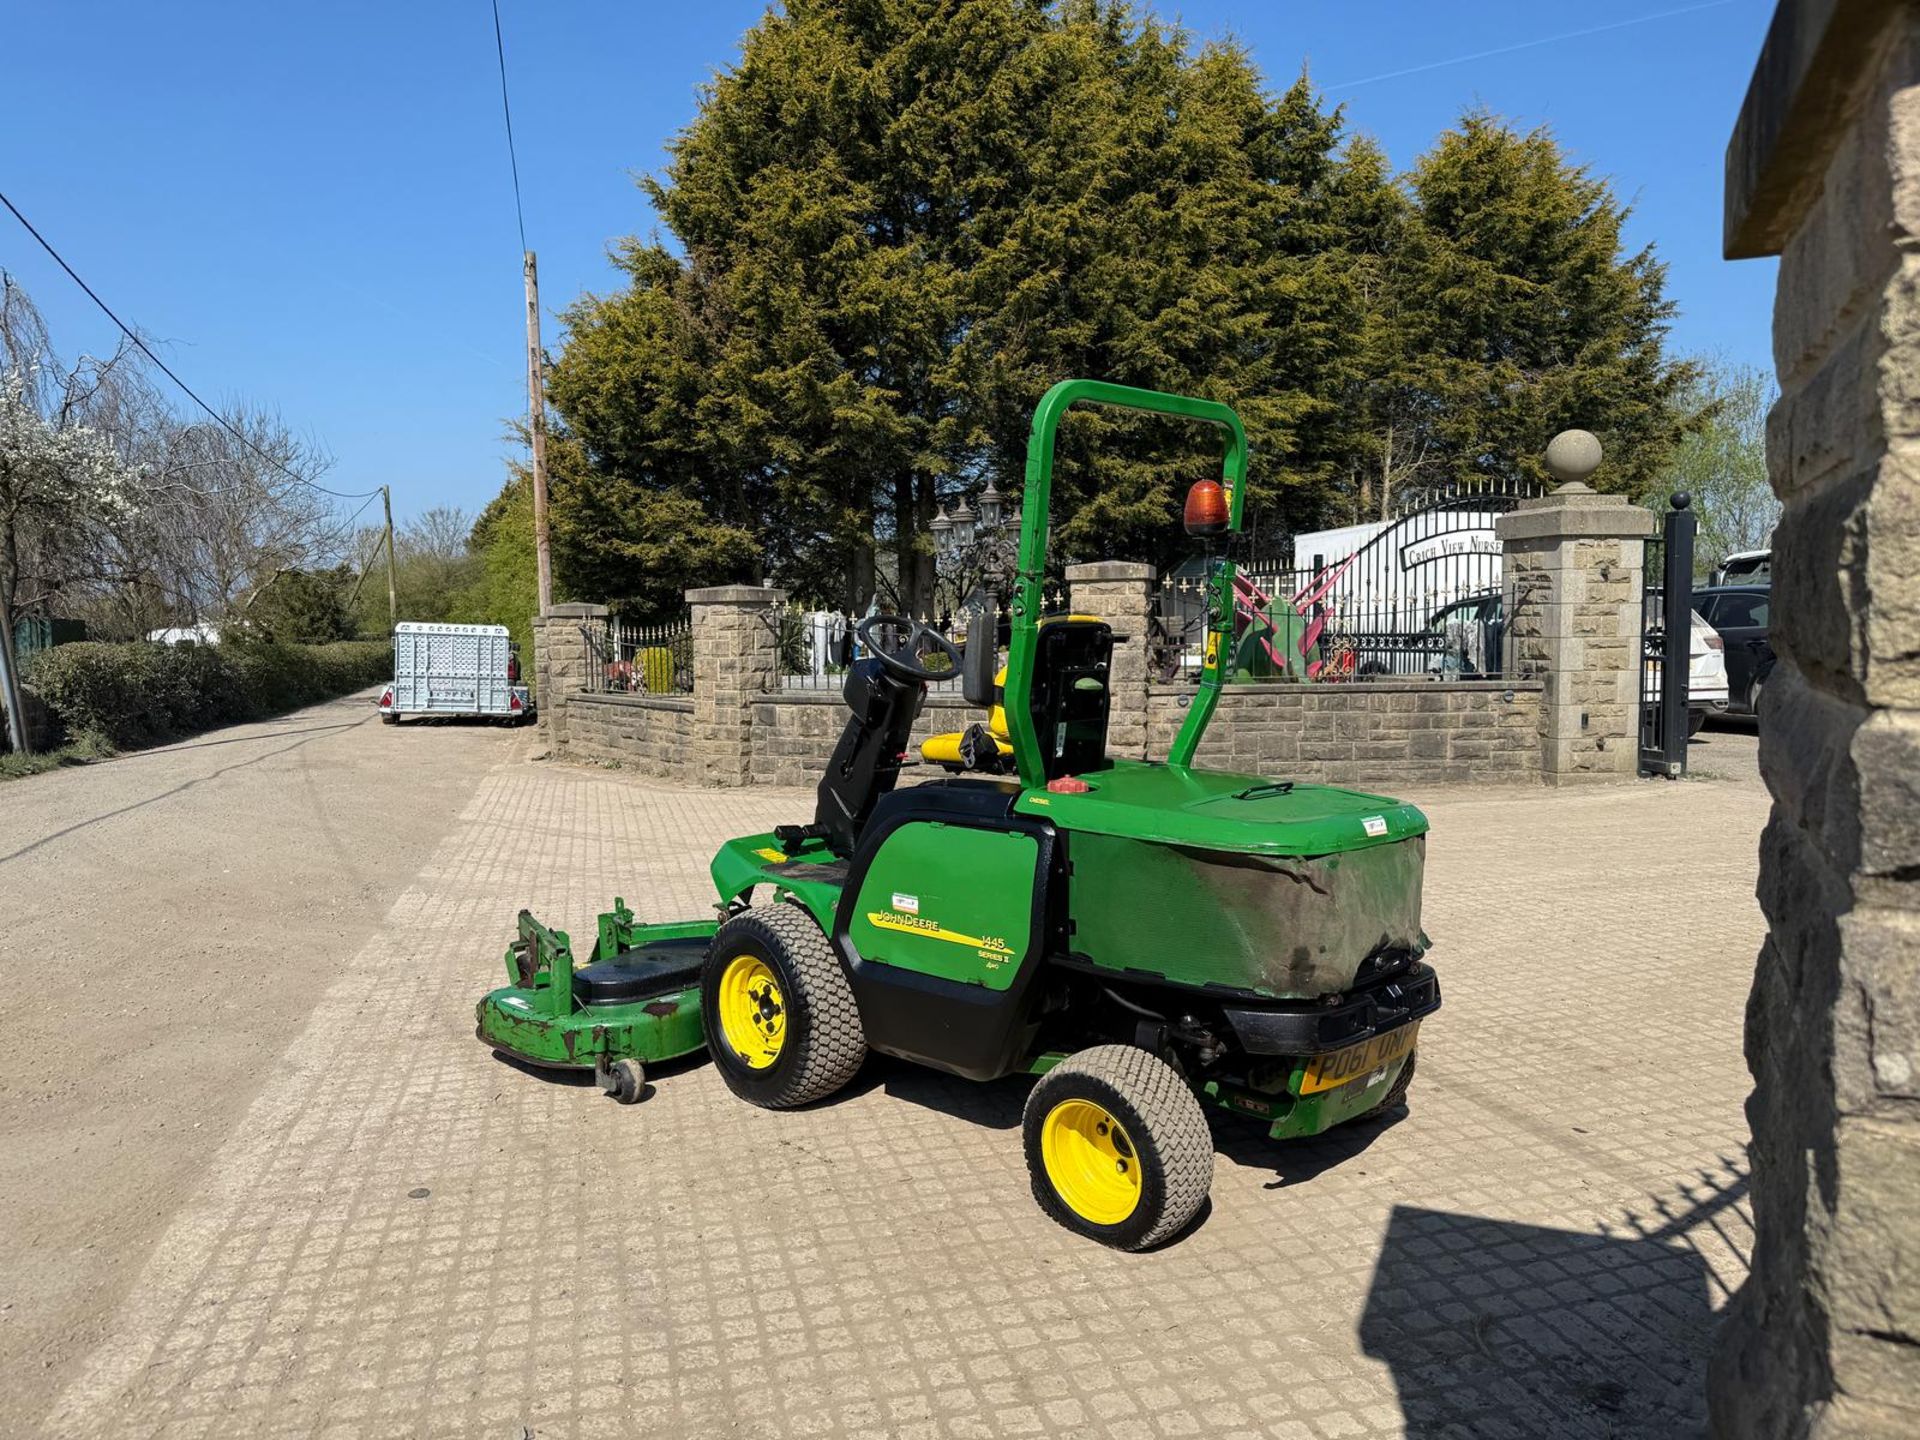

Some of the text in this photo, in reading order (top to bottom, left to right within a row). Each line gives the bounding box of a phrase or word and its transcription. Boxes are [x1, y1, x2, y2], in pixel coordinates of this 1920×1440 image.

[1409, 547, 1436, 565] CRICH
[1441, 539, 1465, 555] VIEW
[982, 935, 1005, 949] 1445
[978, 950, 1003, 962] SERIES
